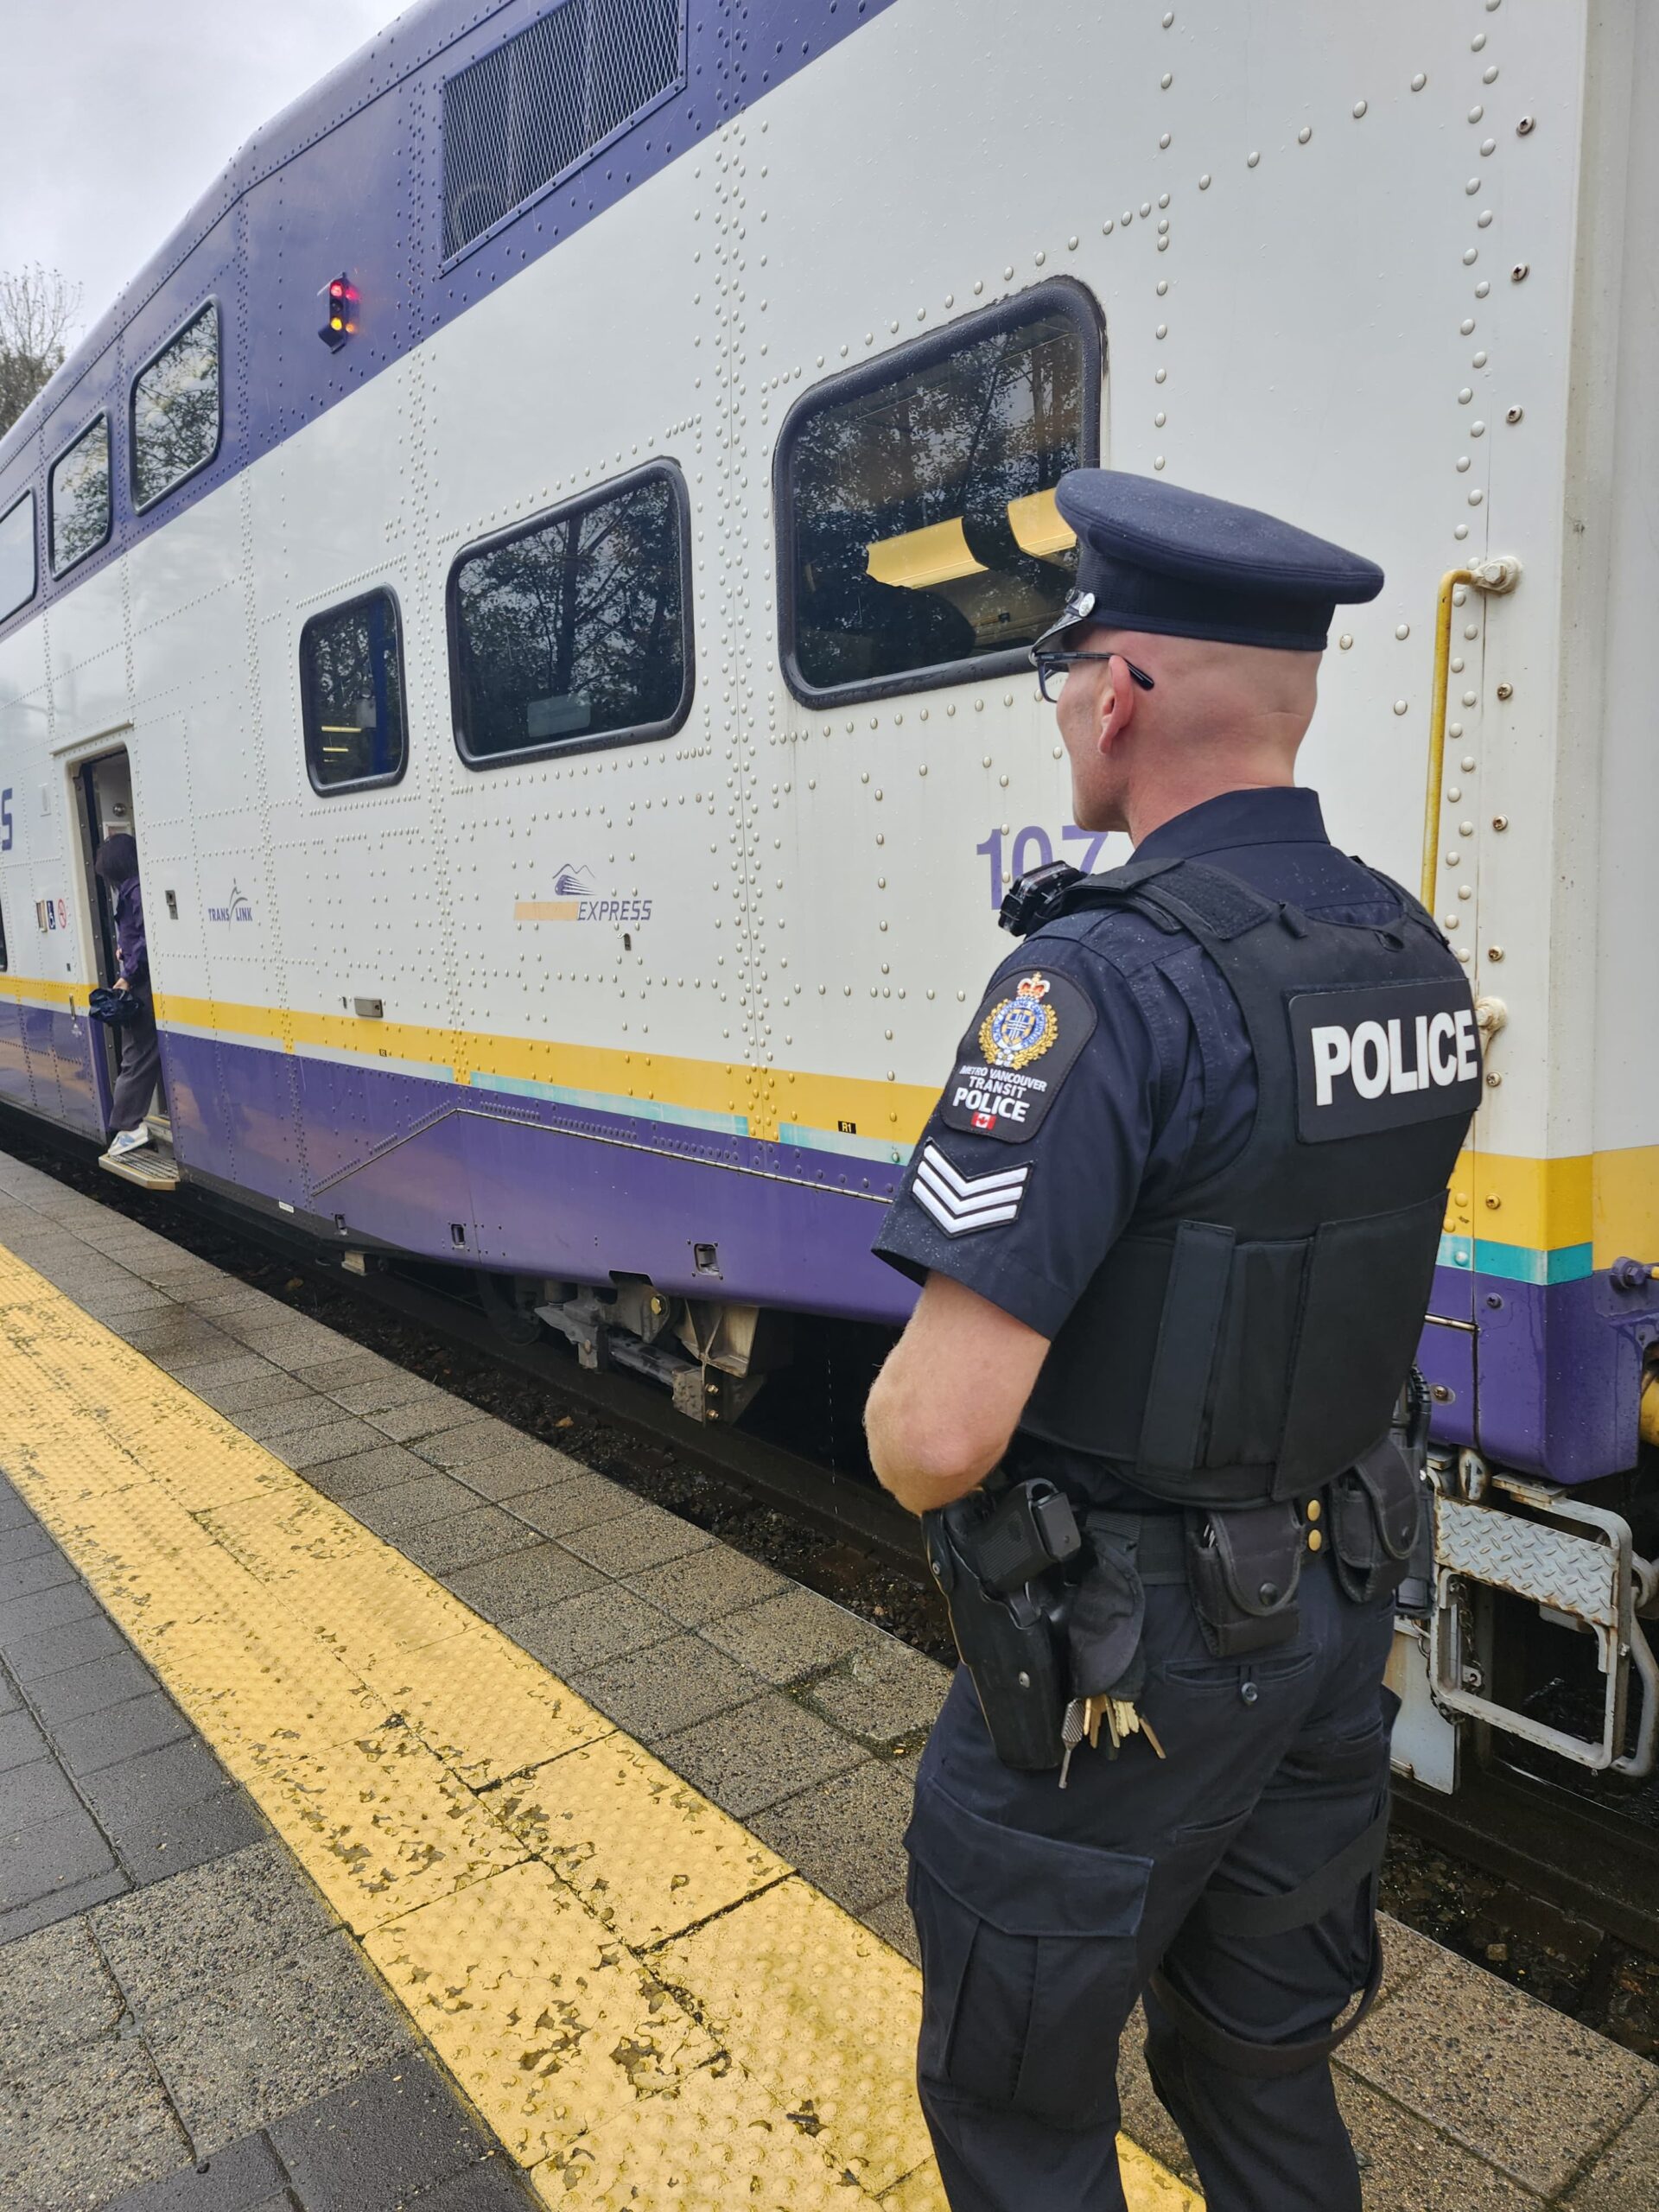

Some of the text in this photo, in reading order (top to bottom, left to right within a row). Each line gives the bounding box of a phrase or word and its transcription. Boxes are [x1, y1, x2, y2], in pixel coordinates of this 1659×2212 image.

[577, 900, 652, 921] EXPRESS
[1311, 1009, 1478, 1106] POLICE
[959, 1065, 1047, 1092] METRO VANCOUVER
[969, 1076, 1027, 1098] TRANSIT
[952, 1087, 1030, 1122] POLICE
